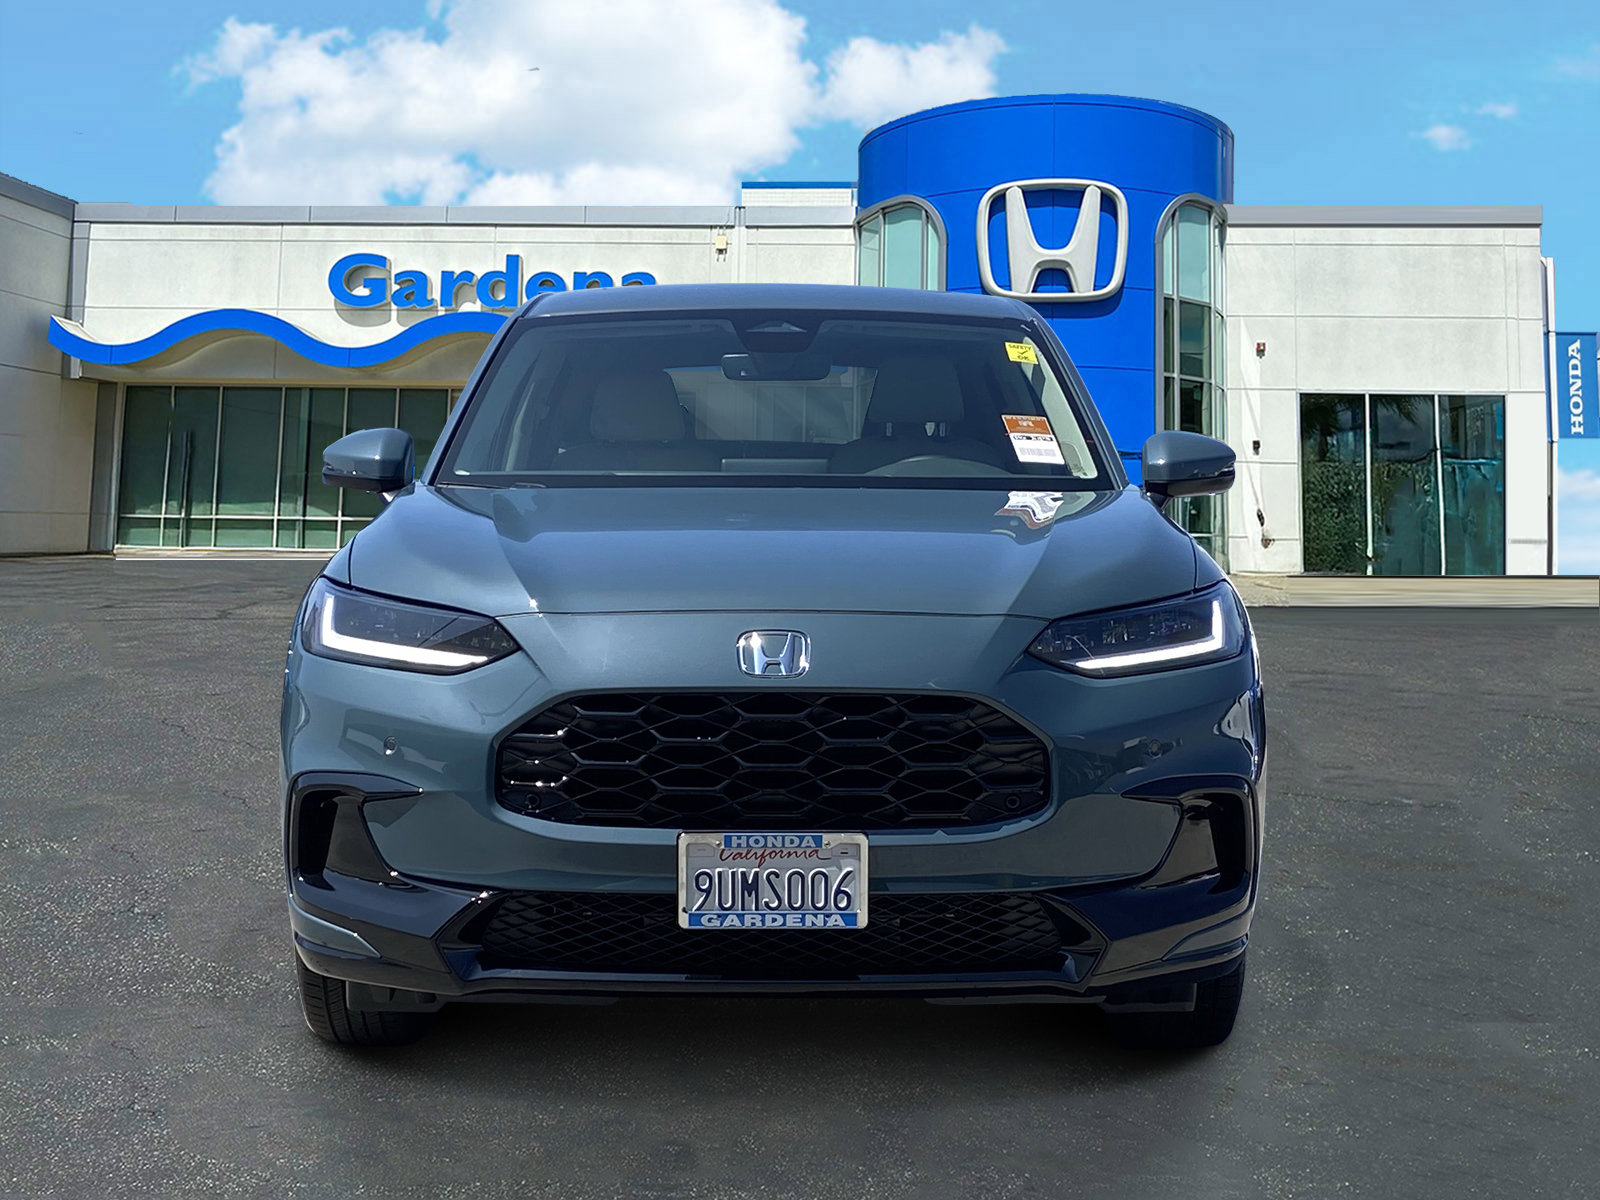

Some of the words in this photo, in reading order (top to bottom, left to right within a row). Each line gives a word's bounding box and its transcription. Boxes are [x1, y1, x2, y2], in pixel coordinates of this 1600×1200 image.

[1567, 339, 1584, 435] HONDA
[731, 835, 816, 848] HONDA
[719, 848, 832, 867] California
[692, 867, 854, 912] 9UMS006
[700, 913, 847, 927] GARDENA
